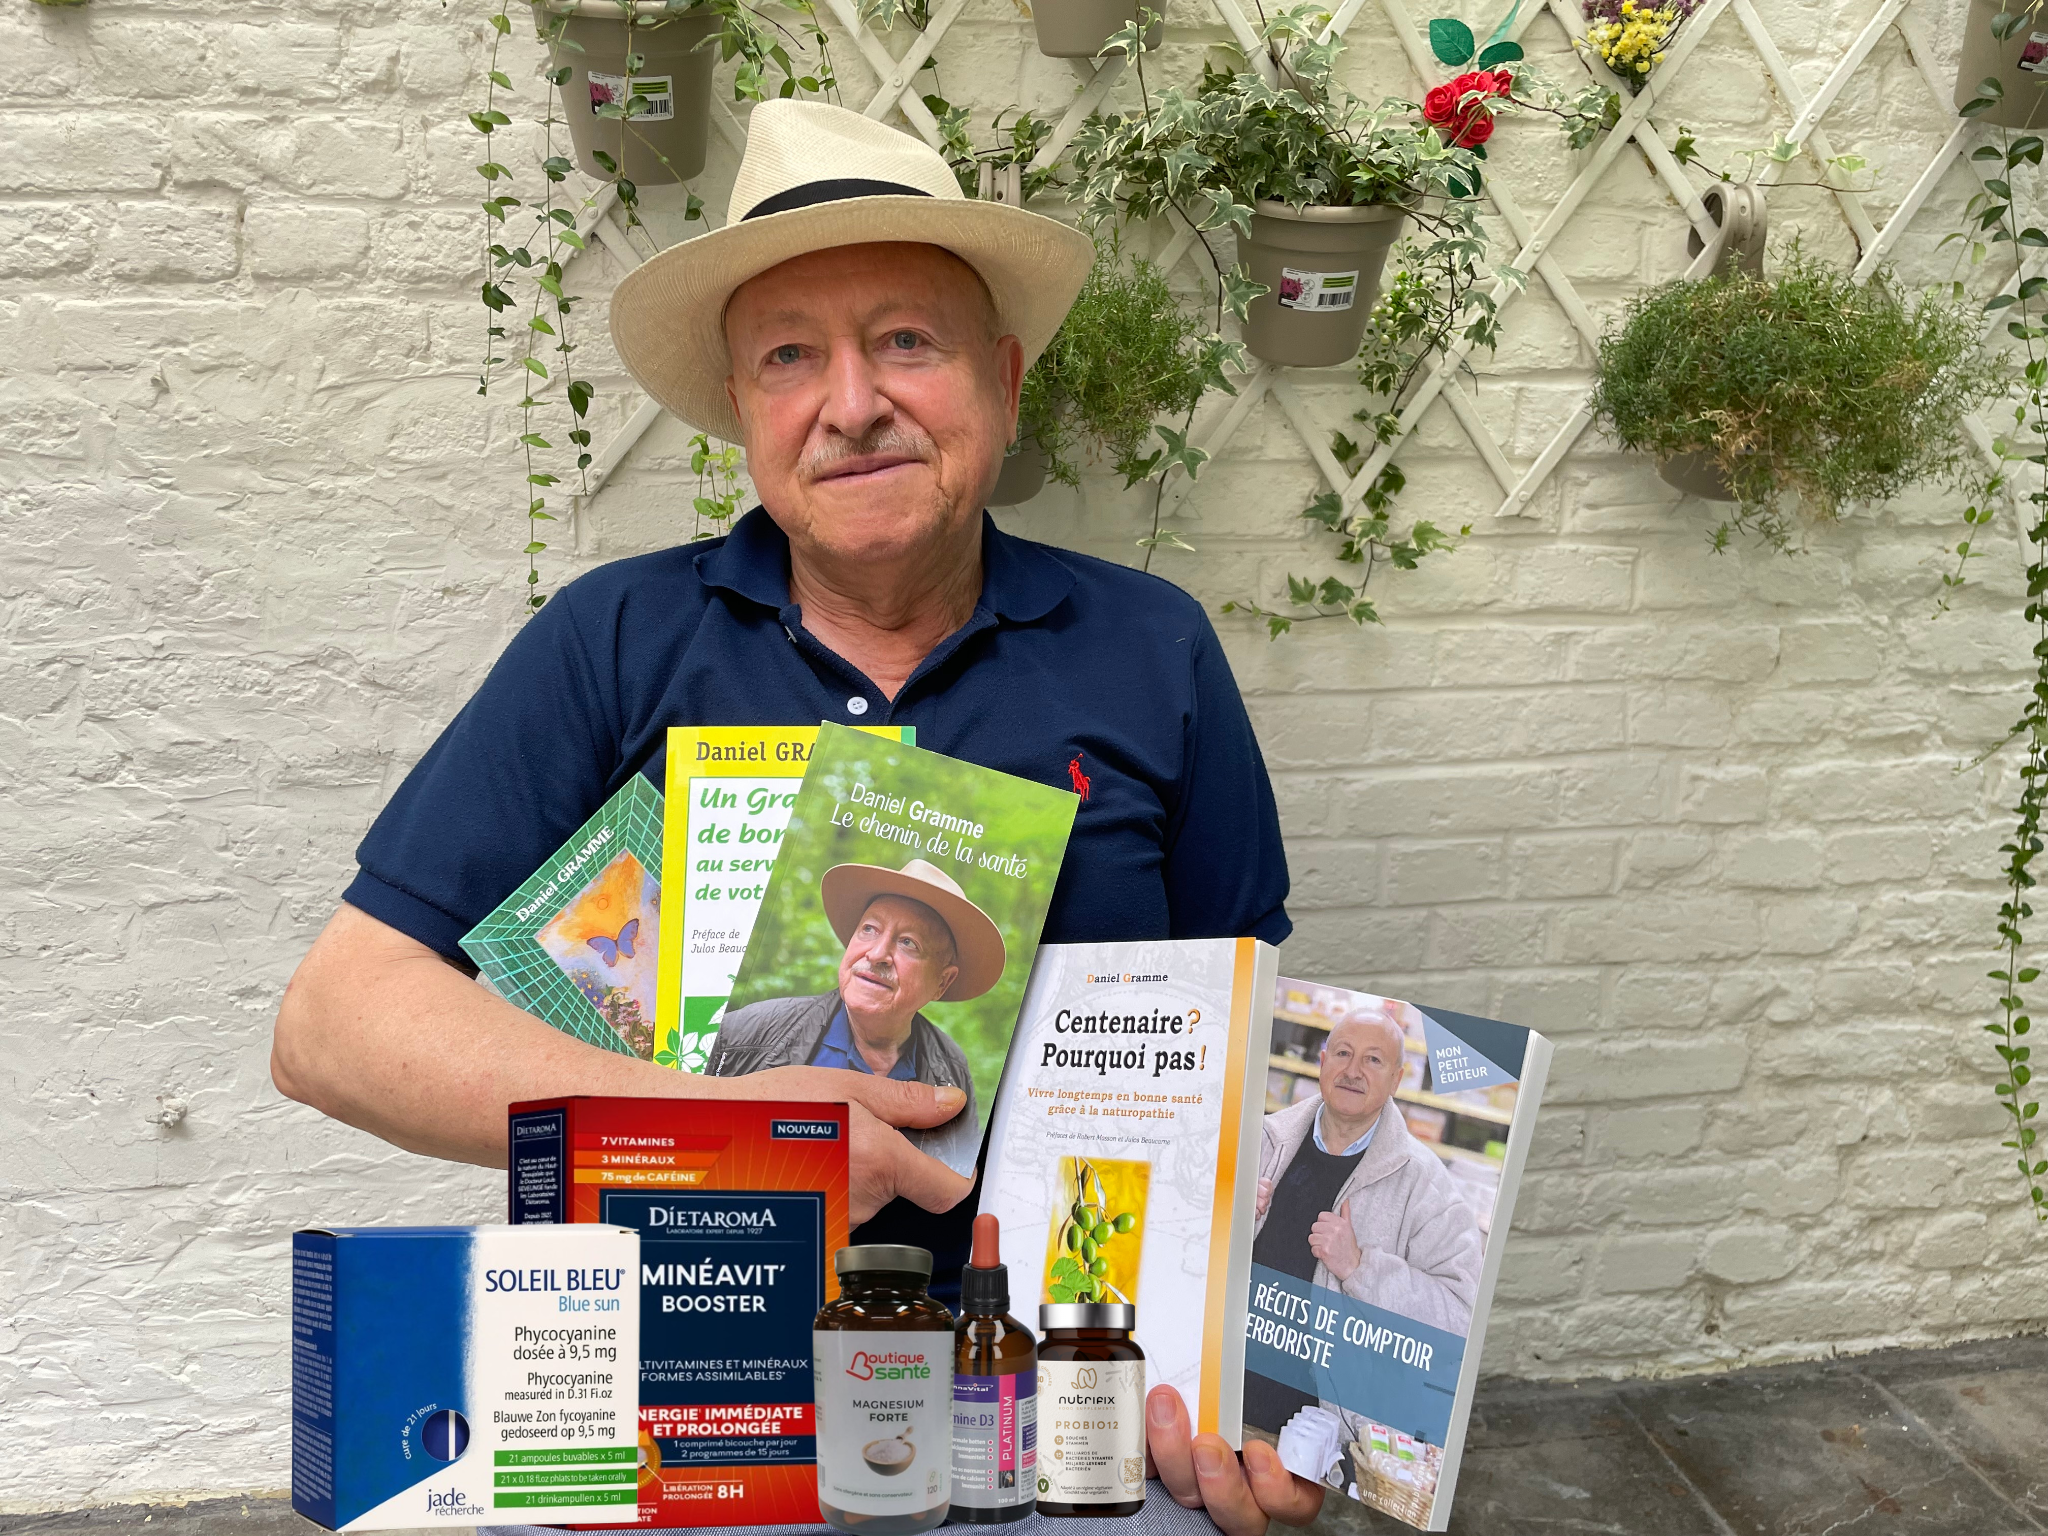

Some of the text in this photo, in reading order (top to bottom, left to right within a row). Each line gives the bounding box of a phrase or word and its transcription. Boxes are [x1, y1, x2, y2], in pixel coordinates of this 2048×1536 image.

[696, 741, 767, 762] Daniel
[700, 788, 738, 808] Un
[850, 782, 984, 839] Daniel Gramme
[697, 822, 731, 844] de
[829, 802, 1028, 879] Le chemin de la santé
[696, 859, 724, 872] au
[516, 826, 614, 922] Daniel GRAMME
[694, 884, 722, 900] de
[692, 928, 740, 942] Préface de
[690, 944, 716, 954] Julos
[1086, 974, 1168, 984] Daniel Gramme
[1040, 1042, 1146, 1076] Pourquoi
[1436, 1046, 1462, 1060] MON
[1438, 1056, 1468, 1072] PETIT
[1440, 1066, 1488, 1084] ÉDITEUR
[1028, 1088, 1202, 1104] Vivre longtemps en bonne santé
[1048, 1104, 1175, 1120] grâce à la naturopathie
[777, 1124, 832, 1135] NOUVEAU
[601, 1136, 675, 1147] 7 VITAMINES
[602, 1153, 676, 1164] 3 MINÉRAUX
[601, 1170, 696, 1184] 75 mg de CAFÉINE
[486, 1268, 561, 1292] SOLEIL
[558, 1296, 620, 1312] Blue sun
[662, 1295, 767, 1312] BOOSTER
[1254, 1282, 1434, 1372] RÉCITS DE COMPTOIR
[514, 1325, 616, 1346] Phycocyanine
[513, 1344, 617, 1362] dosée à 9,5 mg
[726, 1360, 740, 1370] ET
[742, 1357, 808, 1369] MINÉRAUX
[874, 1362, 931, 1380] santé
[527, 1370, 614, 1388] Phycocyanine
[641, 1372, 693, 1382] FORMES
[555, 1388, 564, 1400] in
[1058, 1394, 1115, 1404] nutrifix
[705, 1404, 802, 1420] IMMÉDIATE
[852, 1400, 924, 1410] MAGNESIUM
[406, 1413, 418, 1426] 21
[493, 1408, 616, 1424] Blauwe Zon fycoyanine
[870, 1412, 908, 1422] FORTE
[980, 1414, 994, 1426] D3
[400, 1425, 412, 1438] de
[500, 1424, 616, 1442] gedoseerd op 9,5 mg
[652, 1418, 781, 1436] ET PROLONGÉE
[1002, 1396, 1013, 1460] PLATINUM
[1056, 1420, 1118, 1430] PROBIO12
[401, 1438, 412, 1460] cure
[674, 1438, 798, 1450] 1 comprimé bicouche par jour
[508, 1454, 518, 1463] 21
[520, 1453, 560, 1464] ampoules
[562, 1452, 599, 1462] buvables
[608, 1452, 613, 1460] 5
[614, 1451, 626, 1460] ml
[681, 1448, 790, 1460] 2 programmes de 15 jours
[500, 1475, 510, 1484] 21
[578, 1474, 588, 1482] be
[588, 1473, 608, 1481] taken
[608, 1472, 626, 1482] orally
[662, 1492, 713, 1500] PROLONGÉE
[717, 1484, 744, 1499] 8H
[926, 1484, 938, 1495] 120
[426, 1487, 466, 1512] jade
[526, 1495, 535, 1504] 21
[538, 1494, 594, 1504] drinkampullen
[604, 1493, 609, 1502] 5
[1362, 1488, 1417, 1519] une collection
